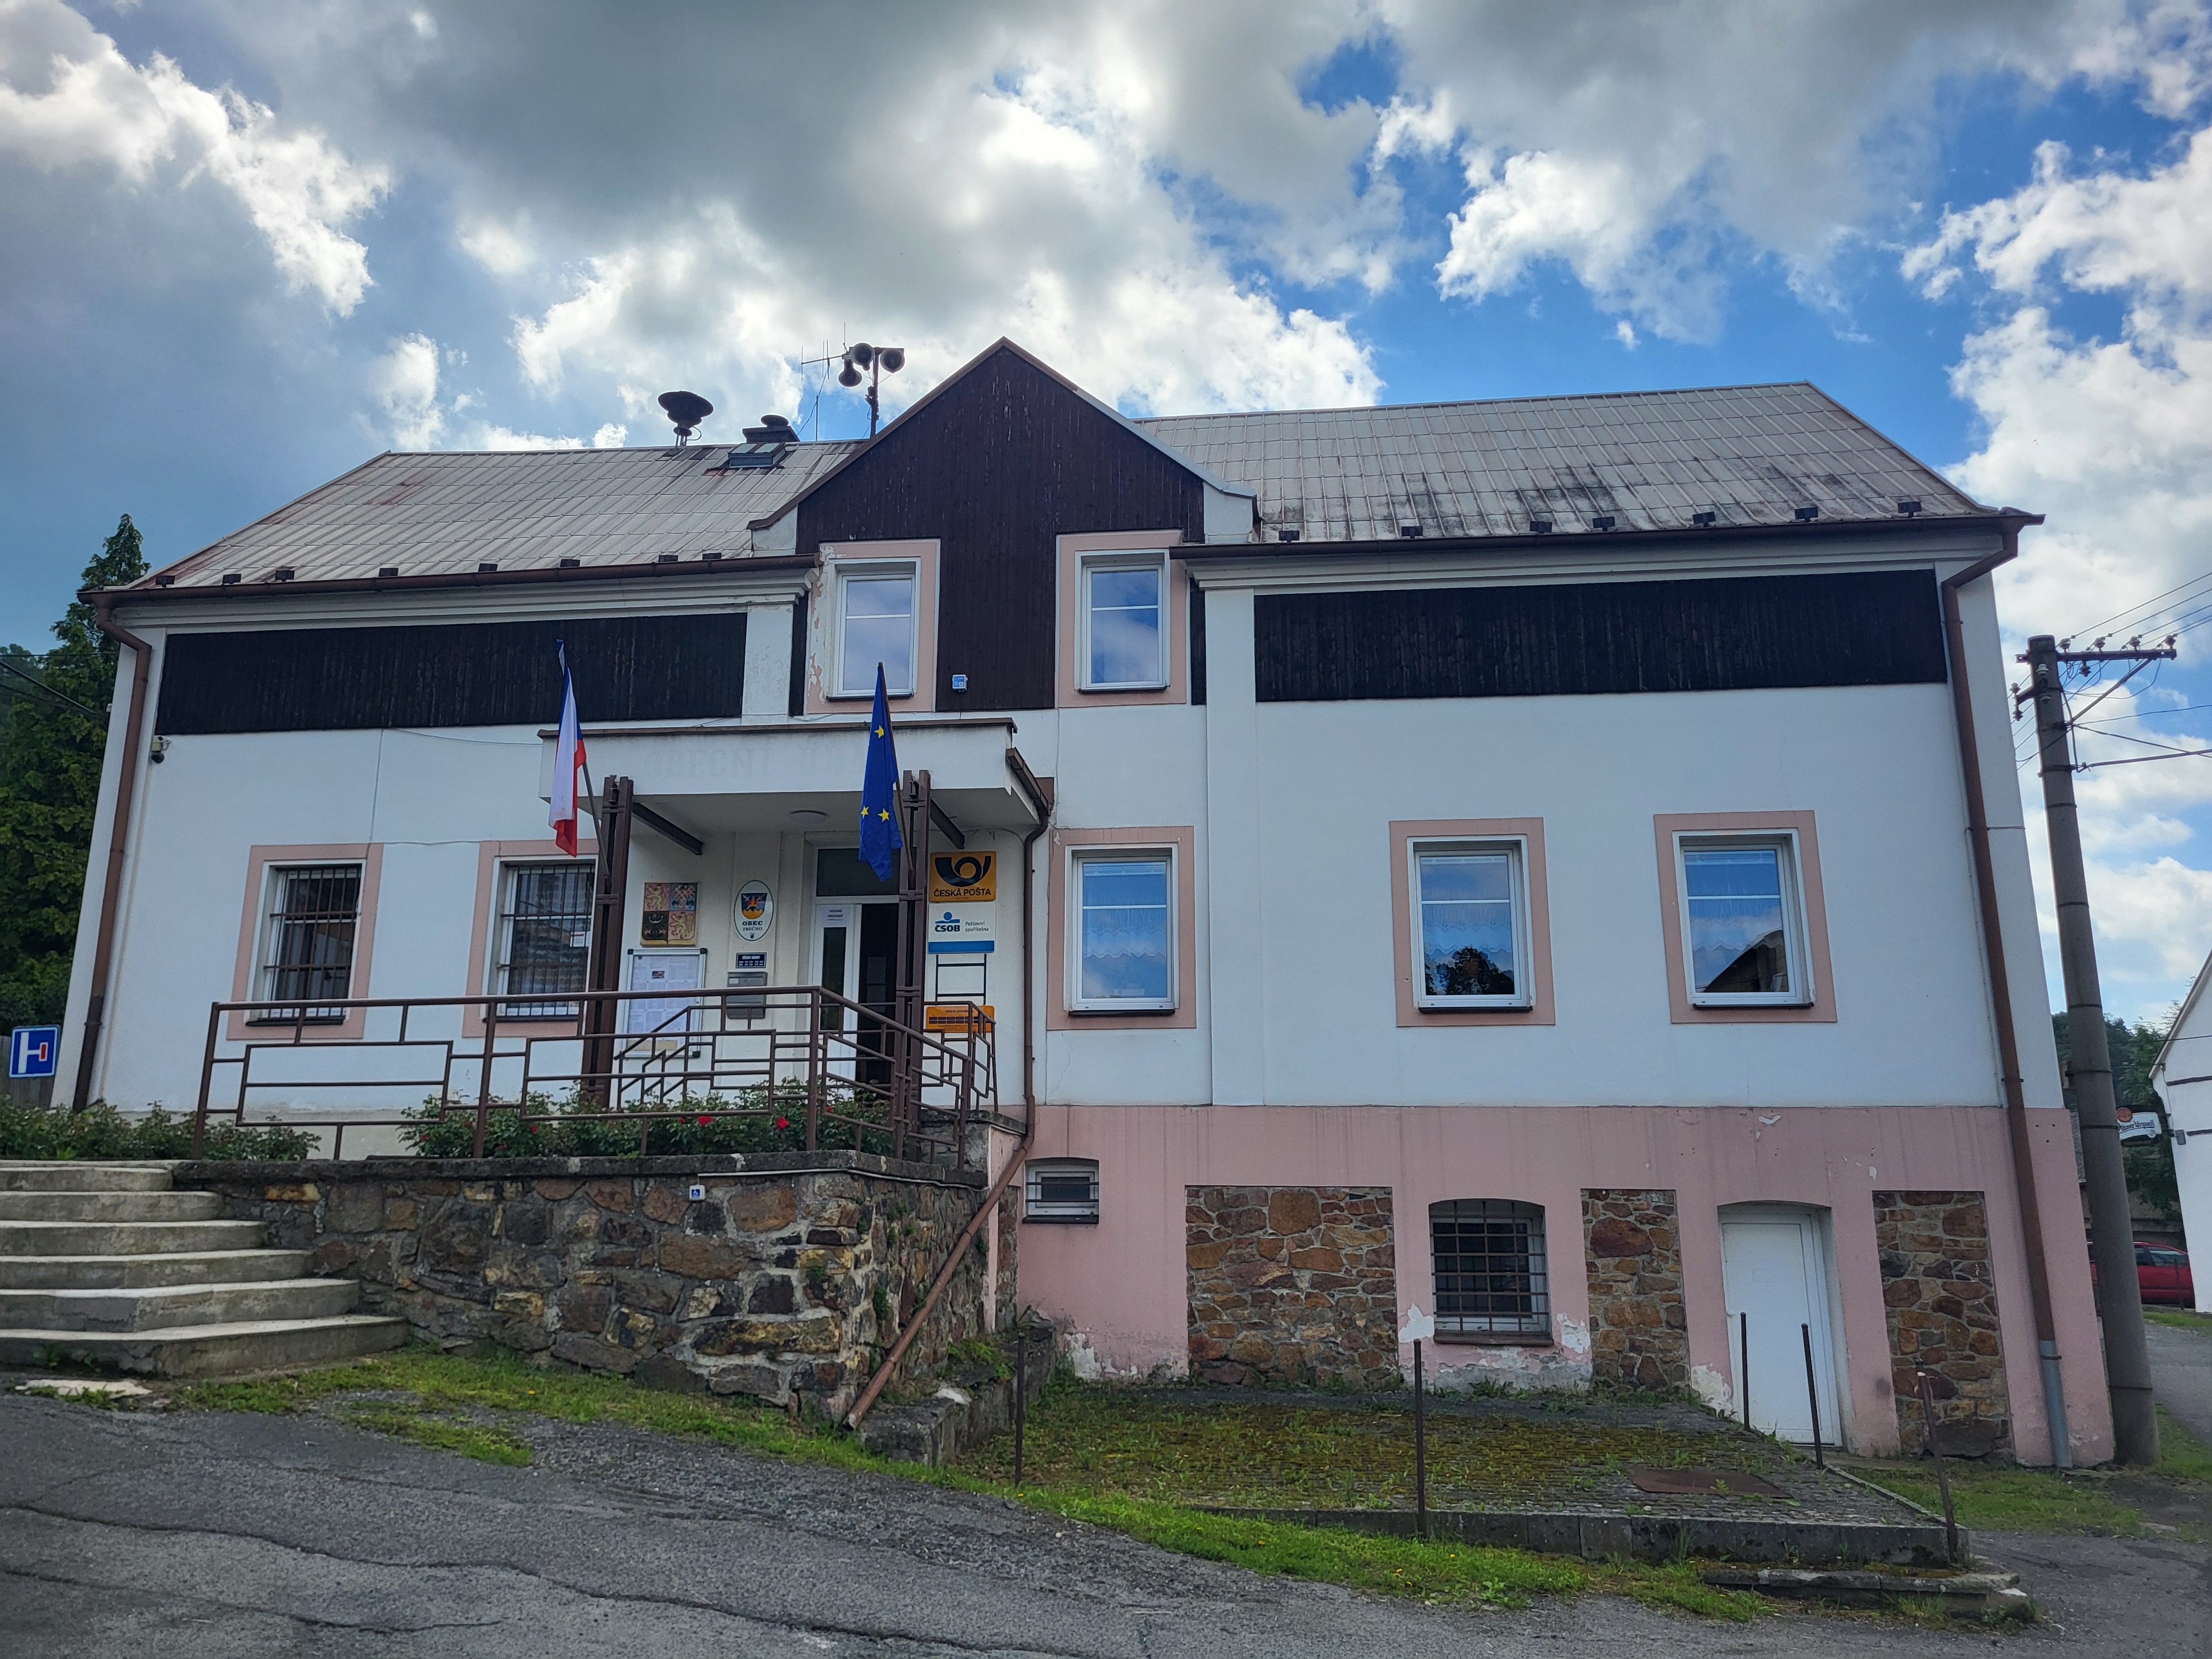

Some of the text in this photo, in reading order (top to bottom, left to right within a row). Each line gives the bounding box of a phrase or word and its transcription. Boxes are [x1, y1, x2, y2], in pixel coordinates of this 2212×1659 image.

[933, 887, 991, 897] ČESKÁ POŠTA
[935, 924, 961, 932] ČSOB
[2133, 1119, 2155, 1129] Urquell
